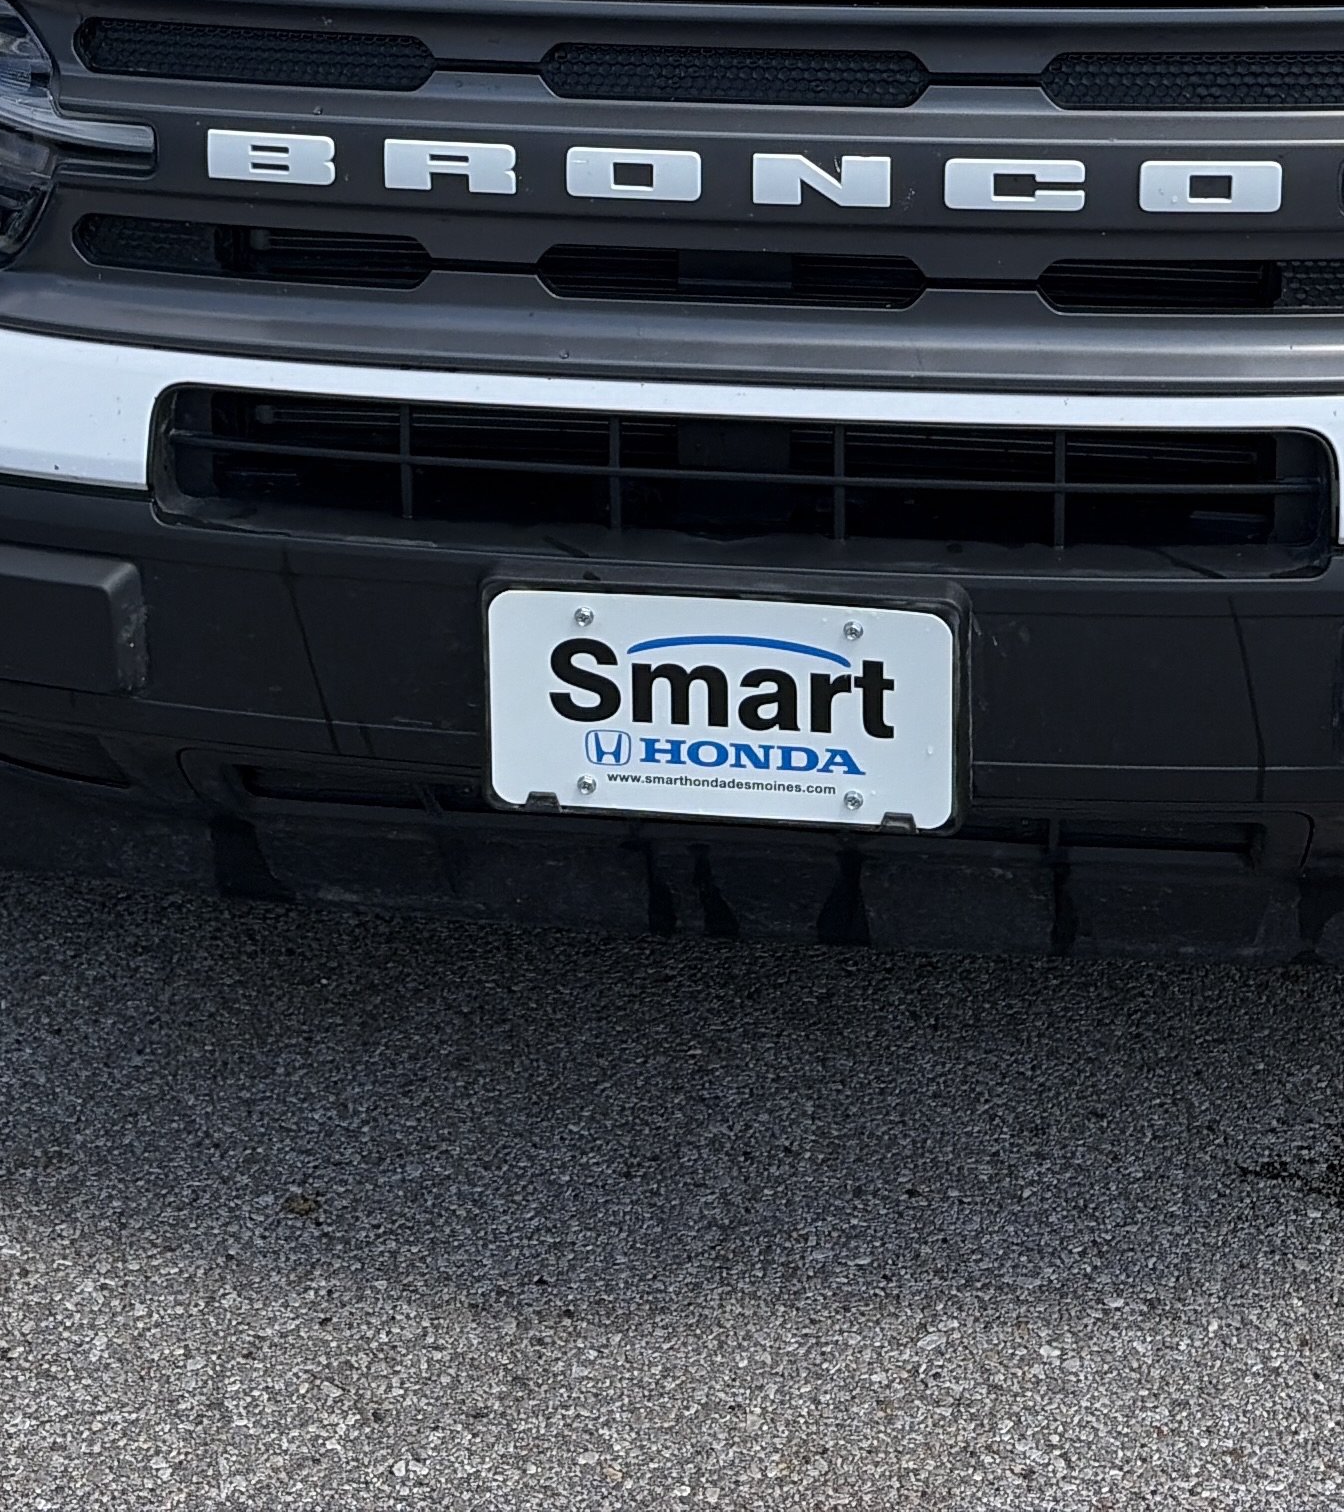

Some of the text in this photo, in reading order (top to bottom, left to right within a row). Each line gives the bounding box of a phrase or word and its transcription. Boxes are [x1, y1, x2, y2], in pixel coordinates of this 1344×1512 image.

[207, 128, 1283, 214] BRONCO
[548, 637, 896, 740] Smart
[607, 772, 837, 796] www.smarthondadesmoines.com
[639, 737, 867, 776] HONDA
